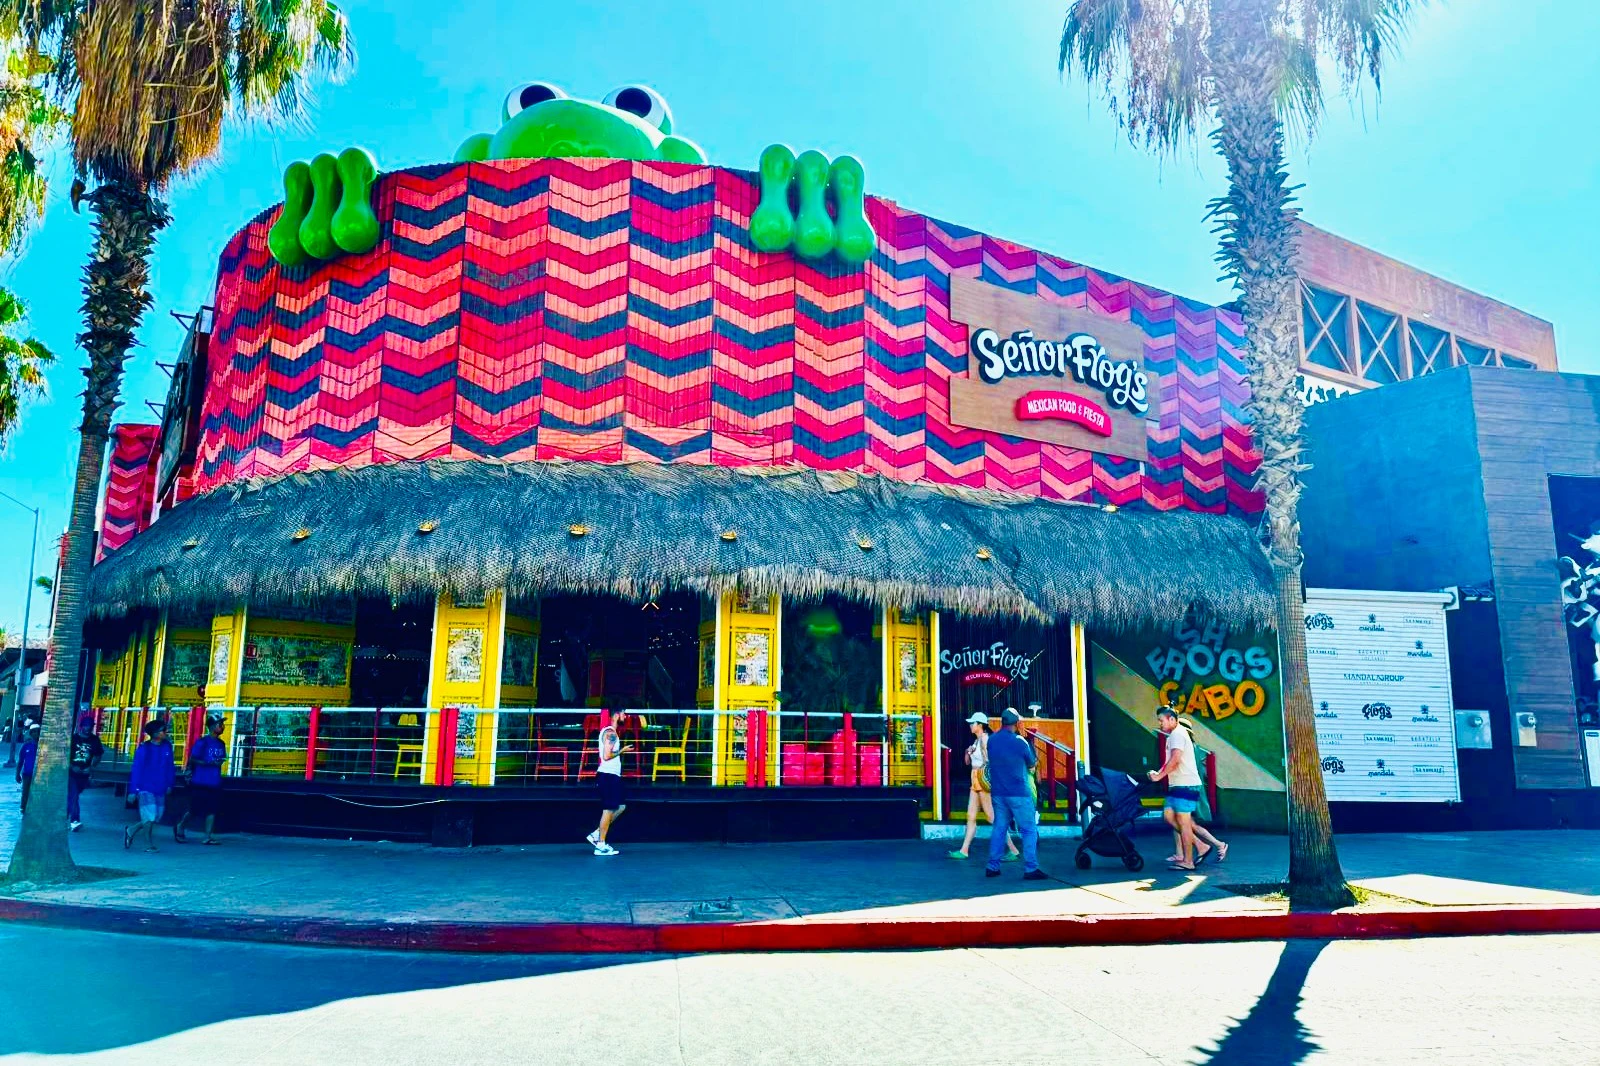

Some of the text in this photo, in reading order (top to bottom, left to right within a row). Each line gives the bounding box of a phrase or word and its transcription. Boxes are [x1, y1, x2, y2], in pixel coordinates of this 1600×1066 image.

[975, 329, 1149, 413] Señor Frog's
[1027, 399, 1058, 414] MEXICAN
[1058, 399, 1077, 413] FOOD
[1083, 407, 1105, 428] FIESTA
[940, 646, 990, 674] Señor
[989, 641, 1032, 680] Frog's
[1145, 644, 1273, 682] FROGS
[1159, 680, 1265, 720] CABO
